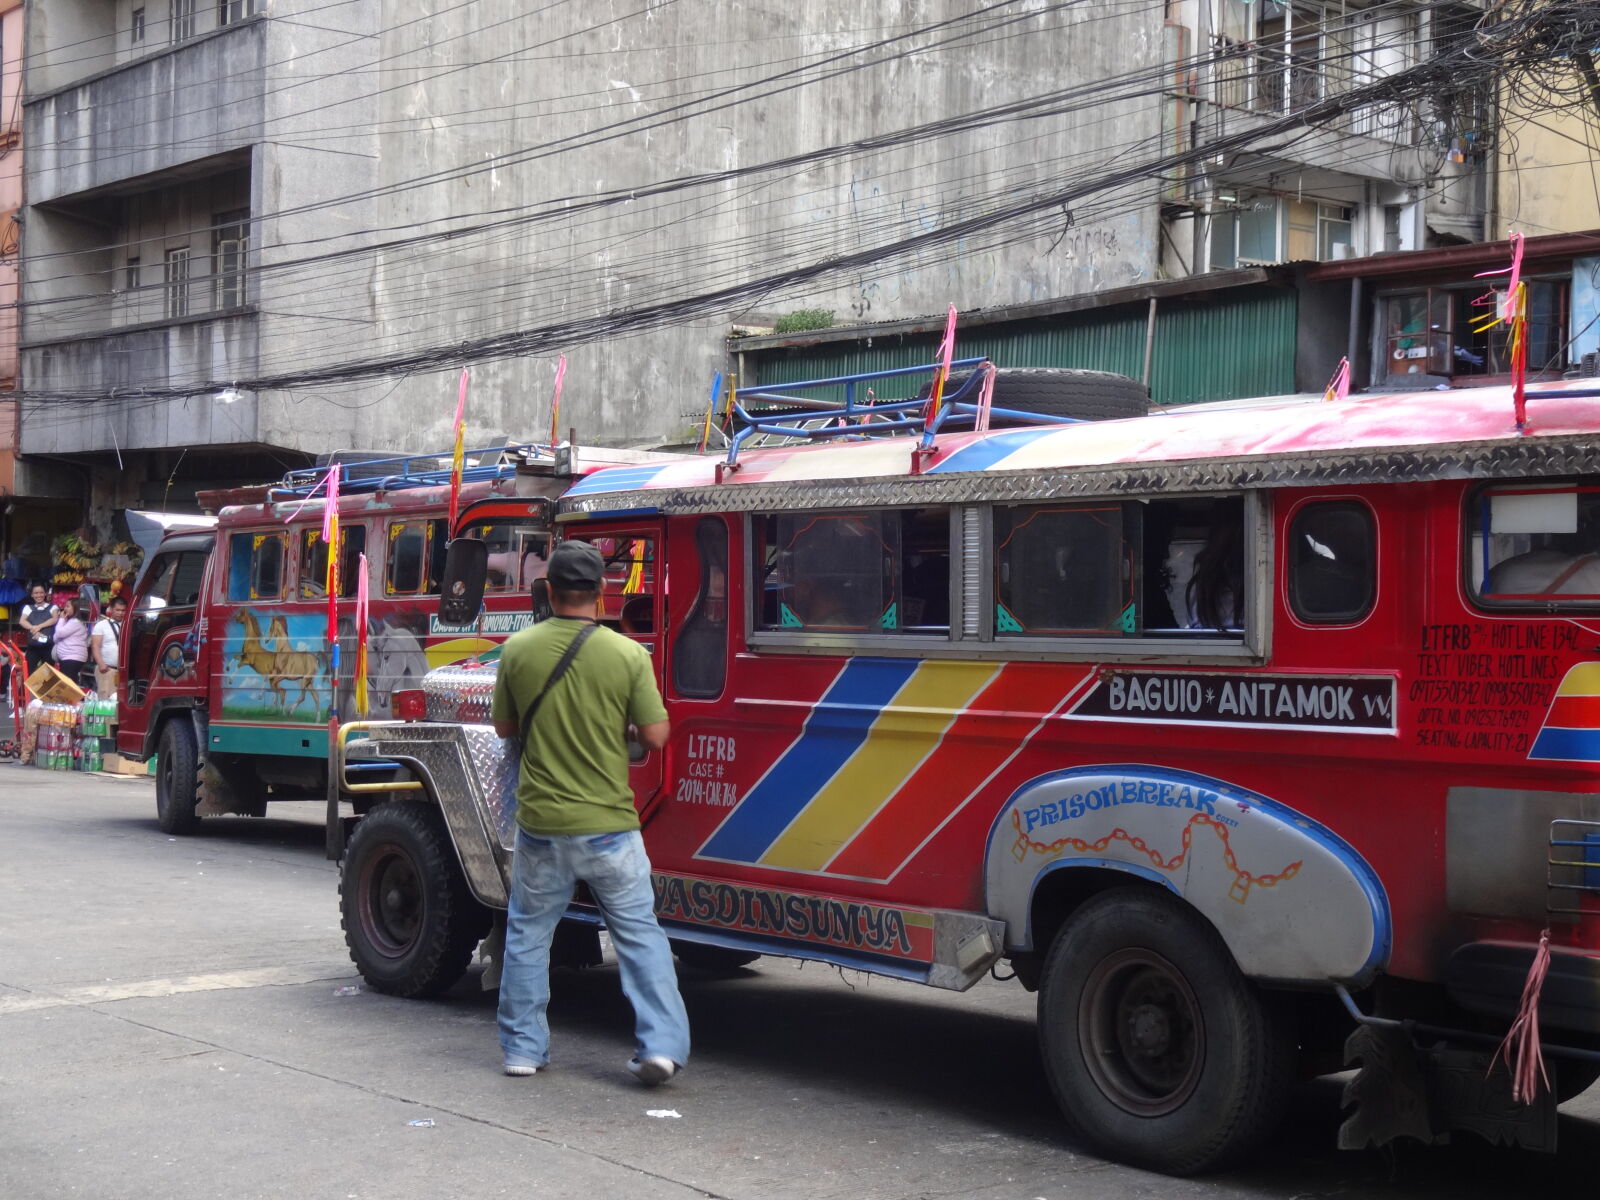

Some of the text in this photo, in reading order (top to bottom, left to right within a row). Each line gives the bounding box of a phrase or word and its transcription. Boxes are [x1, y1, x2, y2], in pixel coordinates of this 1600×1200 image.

[1421, 624, 1471, 651] LTFRB
[1109, 676, 1201, 712] BAGUIO
[1217, 680, 1355, 721] ANTAMOK
[688, 733, 737, 762] LTFRB
[688, 761, 725, 778] CASE #
